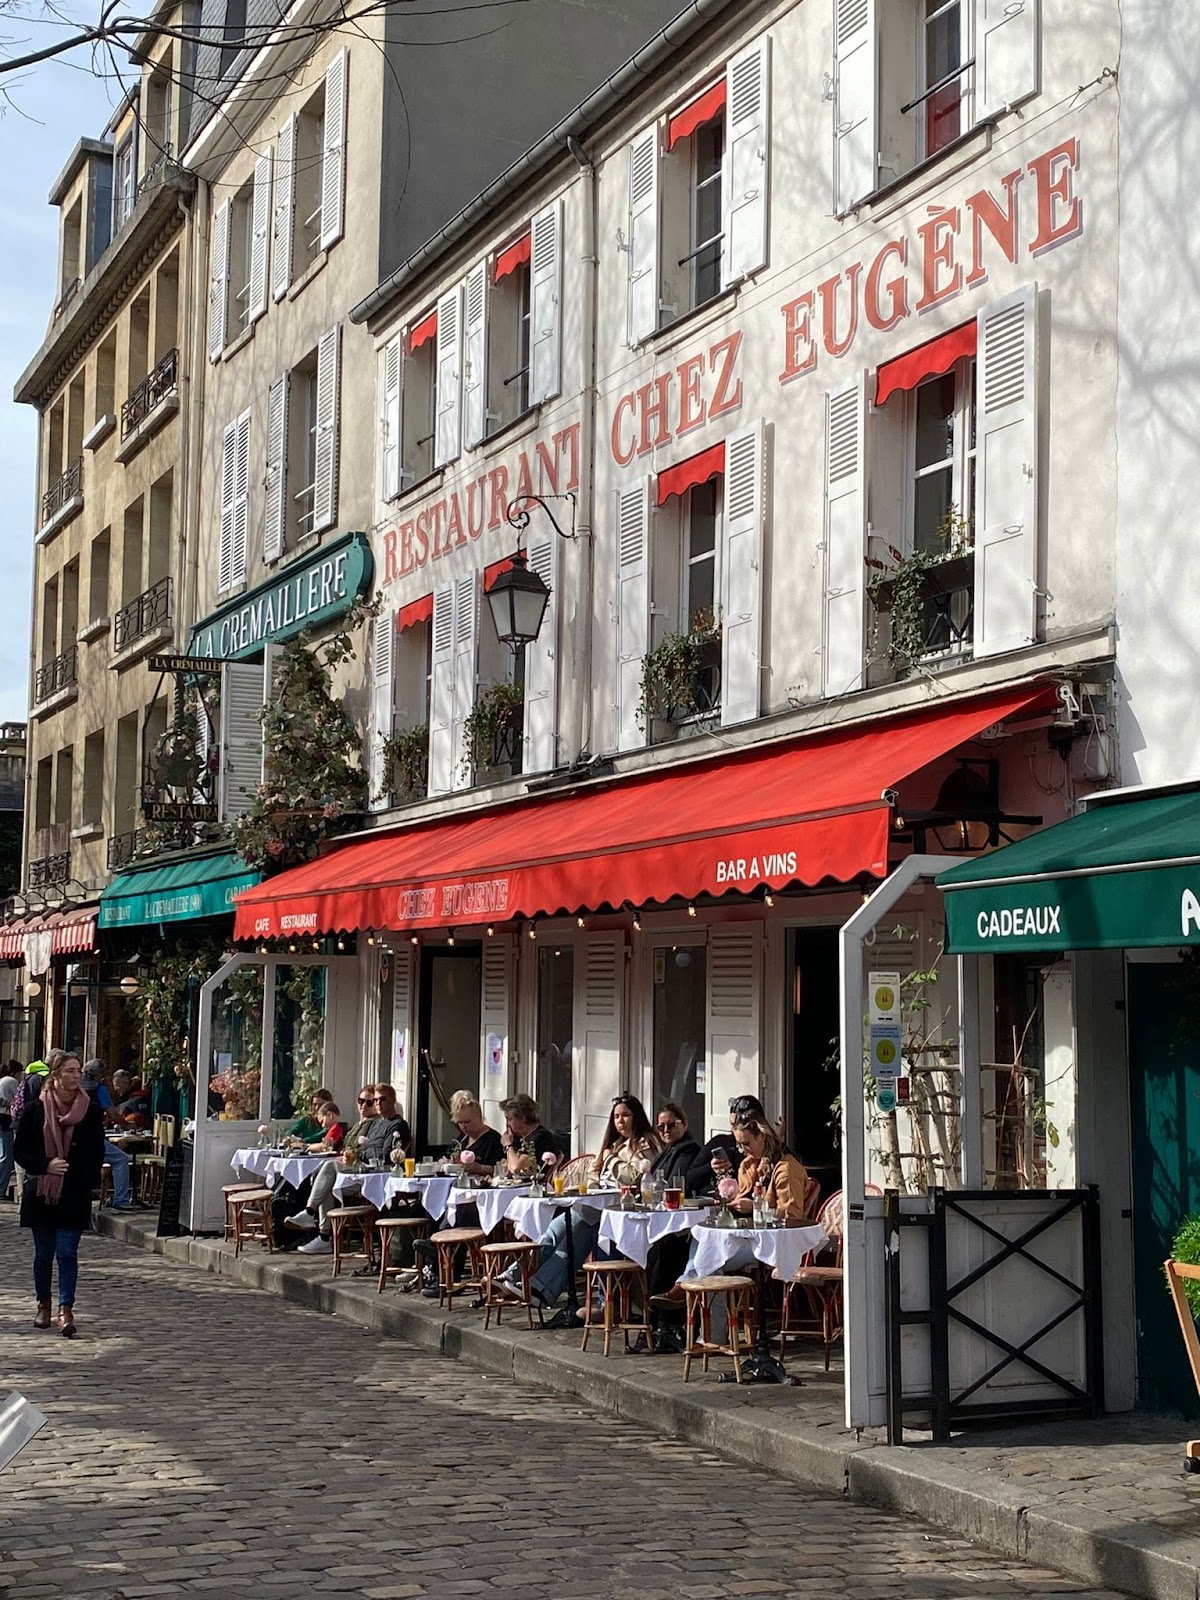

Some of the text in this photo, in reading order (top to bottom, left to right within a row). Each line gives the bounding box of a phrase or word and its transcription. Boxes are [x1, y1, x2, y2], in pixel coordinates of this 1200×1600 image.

[382, 136, 1084, 587] RESTAURANT CHEZ EUGÈNE
[220, 552, 348, 657] CREMAILLERE
[155, 657, 168, 668] LA
[716, 851, 797, 883] BAR A VINS
[397, 878, 509, 920] CHEZ EUGENE
[255, 913, 318, 932] CAFE RESTAURANT
[977, 905, 1061, 938] CADEAUX
